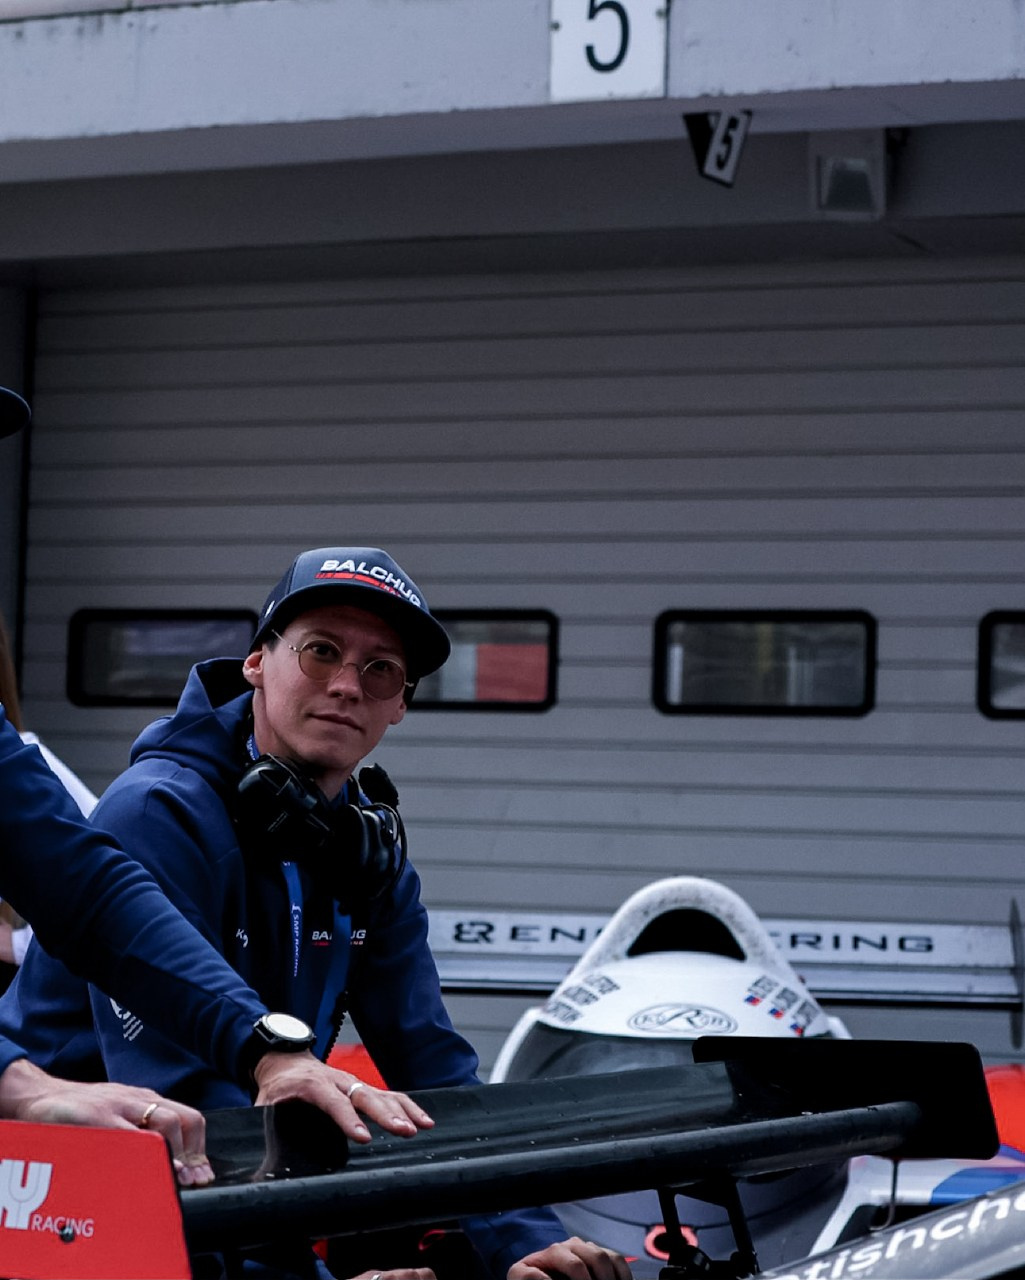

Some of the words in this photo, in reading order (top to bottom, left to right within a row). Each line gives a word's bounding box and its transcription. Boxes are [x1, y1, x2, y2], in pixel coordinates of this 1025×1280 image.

[585, 0, 630, 73] 5
[716, 116, 739, 171] 5
[320, 559, 422, 608] BALCHUG
[31, 1213, 95, 1238] RACING
